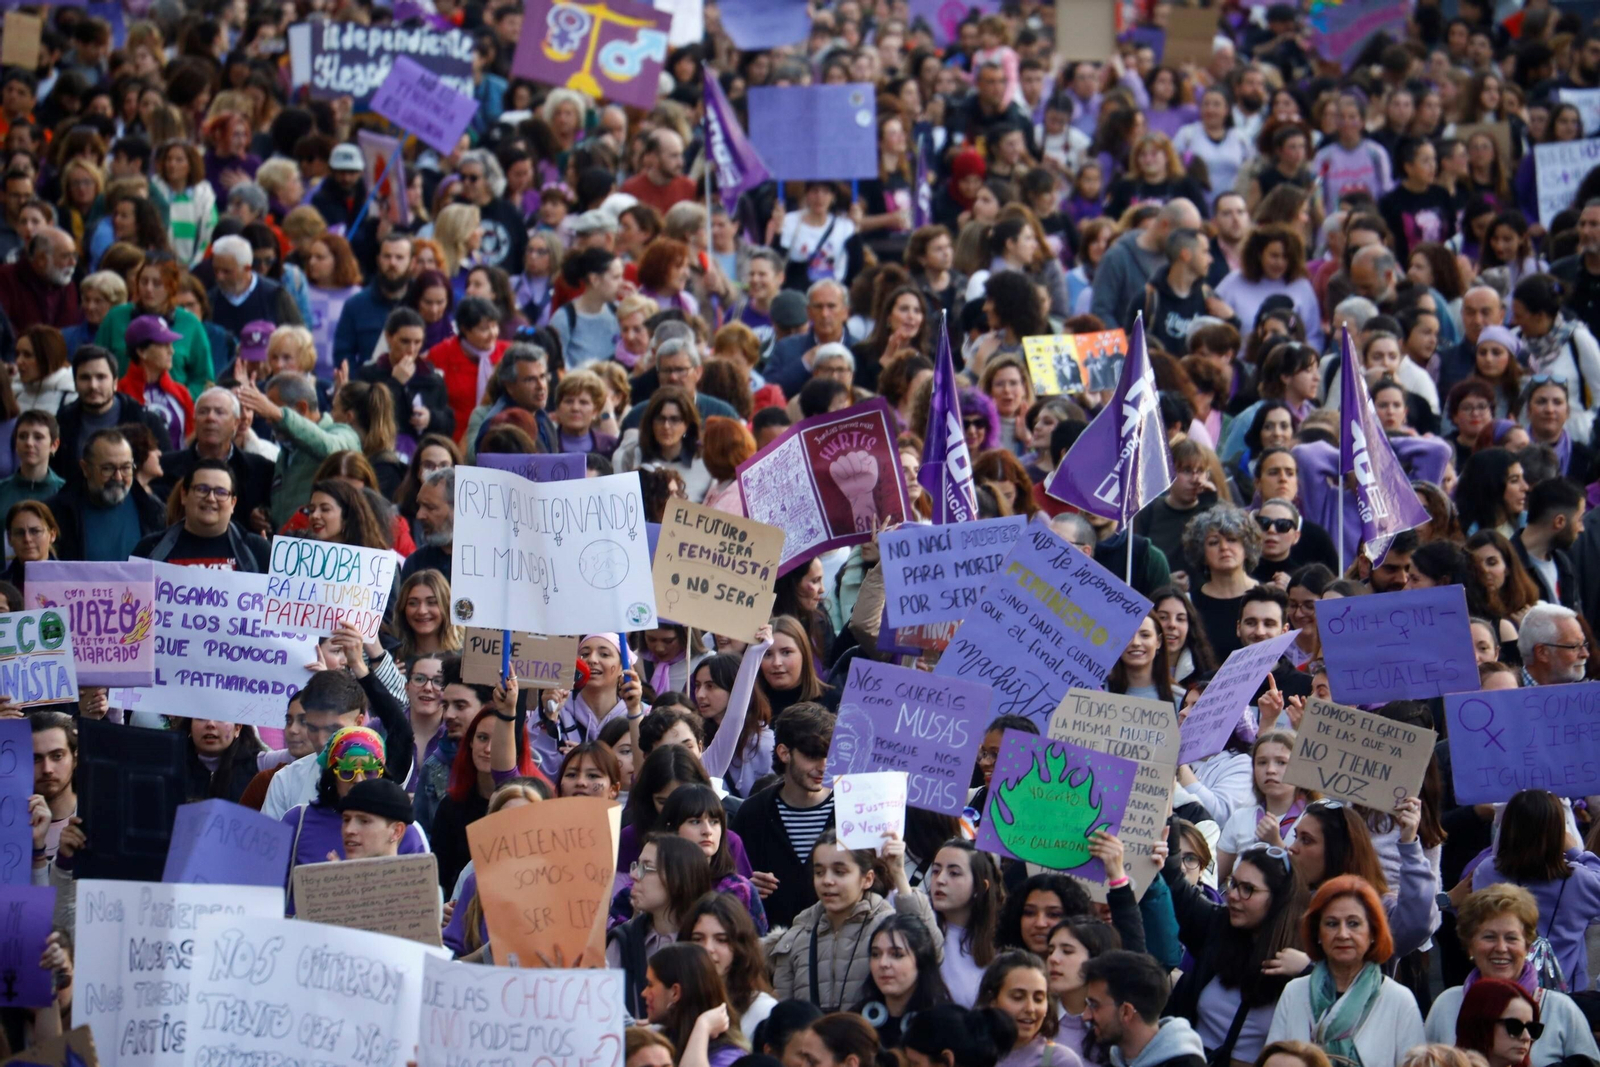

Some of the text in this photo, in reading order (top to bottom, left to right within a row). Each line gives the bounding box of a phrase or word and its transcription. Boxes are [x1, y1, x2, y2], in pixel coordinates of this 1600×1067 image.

[674, 508, 748, 543] EL FUTURO
[272, 538, 361, 583] CÓRDOBA
[462, 544, 484, 577] EL
[718, 541, 755, 558] SERÁ
[887, 539, 911, 561] NO
[917, 528, 952, 555] NACÍ
[671, 573, 759, 609] O NO SERÁ
[902, 563, 945, 587] PARA
[1059, 582, 1074, 597] EL
[92, 587, 114, 598] ESTE
[266, 576, 387, 613] RÁ LA TUMBA DEL
[899, 593, 932, 616] POR
[180, 612, 221, 633] LOS
[264, 598, 381, 639] PATRIARCADO
[980, 600, 1006, 624] QUE
[996, 587, 1029, 616] SINO
[1028, 613, 1066, 648] DARTE
[154, 635, 288, 666] QUE PROVOCA
[153, 667, 300, 699] L PATRIARCADO
[1341, 658, 1460, 691] IGUALES
[894, 682, 967, 711] QUERÉIS
[1069, 694, 1170, 729] TODAS SOMOS
[893, 702, 970, 749] MUSAS
[1055, 717, 1068, 730] LA
[1071, 720, 1112, 737] MISMA
[1310, 702, 1417, 744] SOMOS EL GRITO
[1316, 721, 1402, 758] DE LAS QUE YA
[934, 751, 962, 767] NOS
[1299, 737, 1392, 781] NO TIENEN
[1476, 761, 1598, 790] IGUALES
[1317, 766, 1370, 801] VOZ
[478, 826, 597, 864] VALIENTES
[514, 864, 574, 890] SOMOS
[523, 906, 555, 936] SER
[207, 927, 286, 986] NOS
[500, 975, 615, 1024] CHICAS
[467, 1020, 576, 1058] PODEMOS
